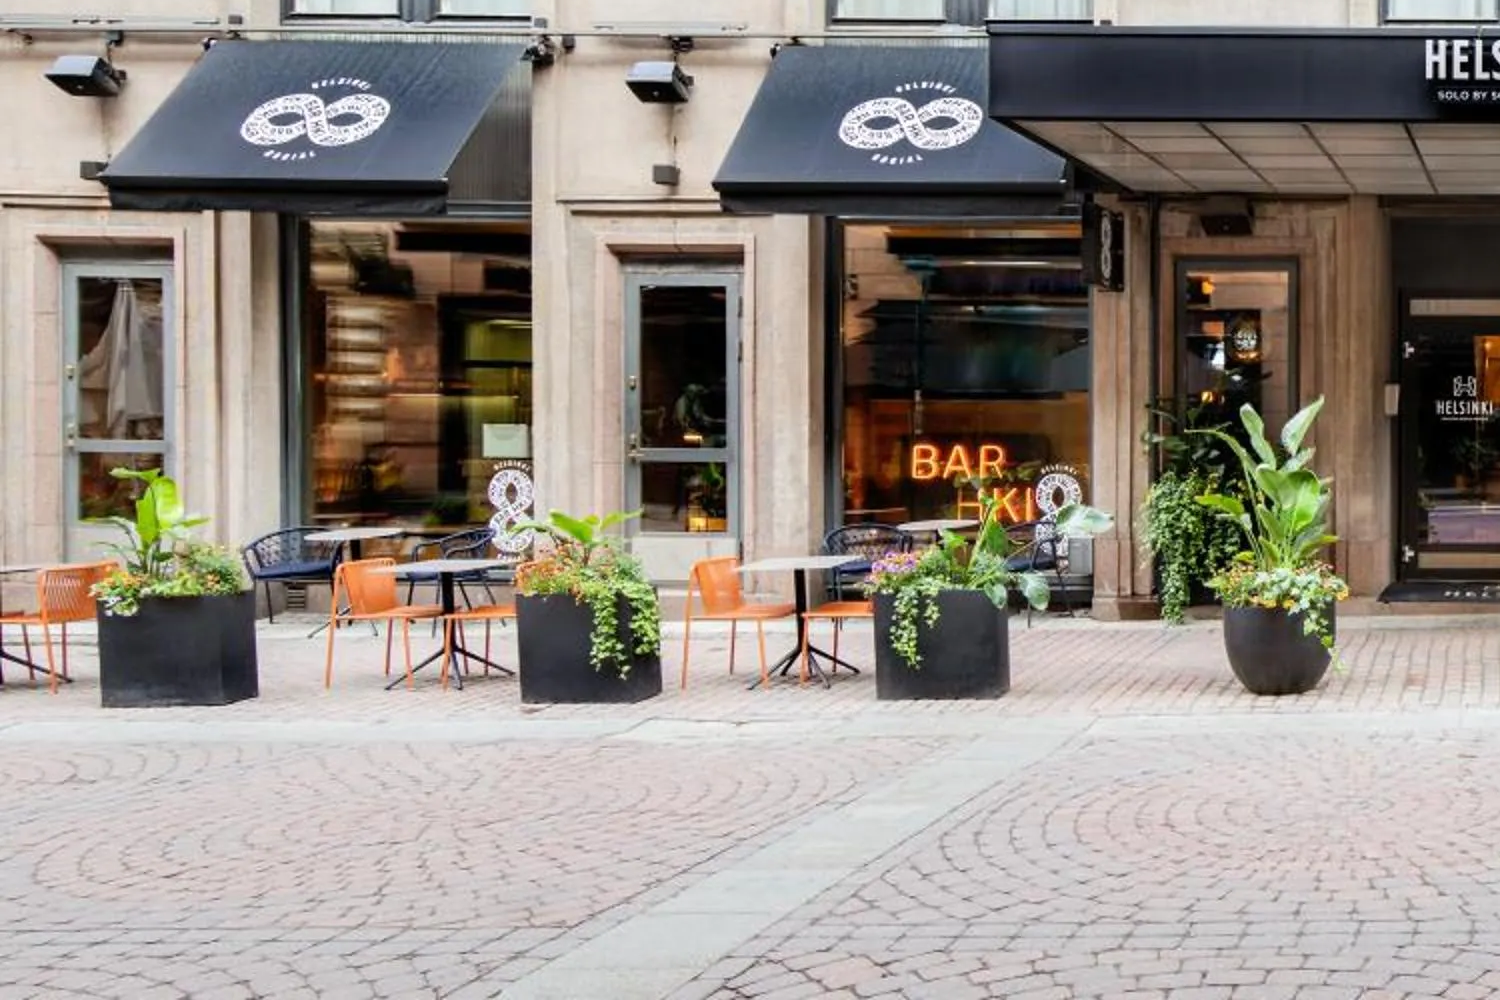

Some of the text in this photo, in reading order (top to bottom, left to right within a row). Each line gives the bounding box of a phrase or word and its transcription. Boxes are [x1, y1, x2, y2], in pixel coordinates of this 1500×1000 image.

[1437, 90, 1470, 101] SOLO
[1473, 90, 1488, 101] BY
[1436, 400, 1493, 415] HELSINKI
[912, 444, 1004, 479] BAR
[957, 487, 1033, 522] HKI
